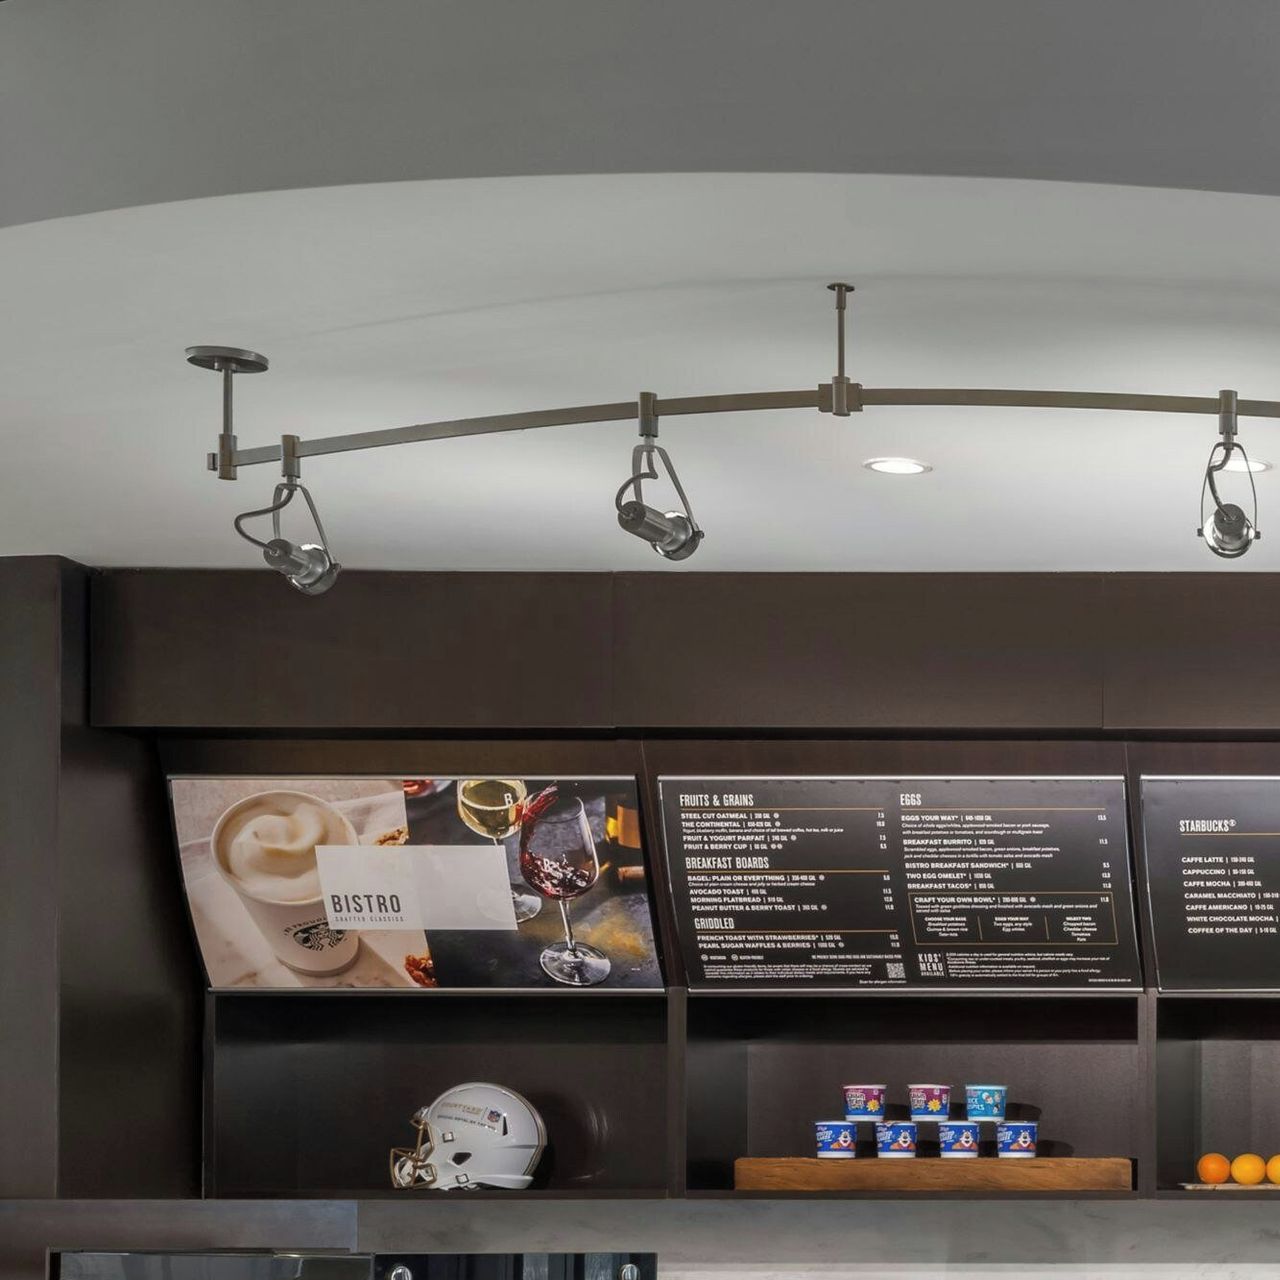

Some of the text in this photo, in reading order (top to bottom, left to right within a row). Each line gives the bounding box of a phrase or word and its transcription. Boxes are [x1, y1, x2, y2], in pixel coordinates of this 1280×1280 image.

[680, 794, 754, 806] FRUITS & GRAINS
[900, 794, 922, 806] EGGS
[685, 857, 770, 869] BREAKFAST BOARDS
[331, 894, 401, 913] BISTRO
[694, 918, 735, 929] GRIDDLED
[919, 963, 943, 971] MENU
